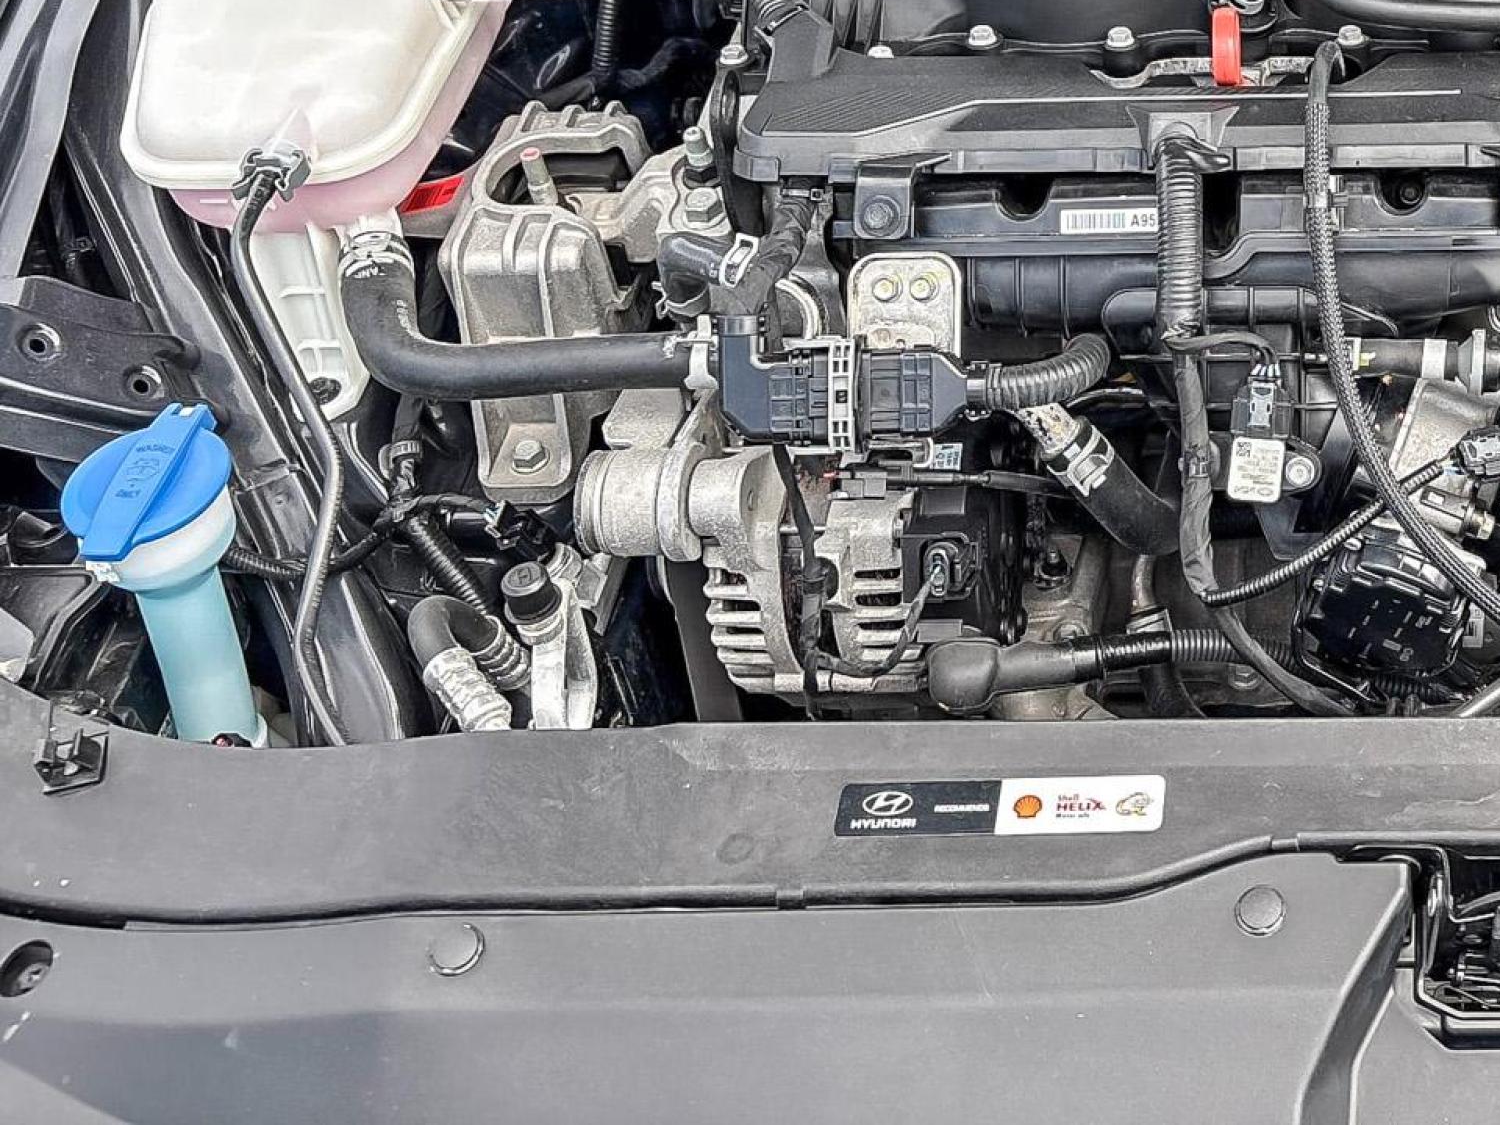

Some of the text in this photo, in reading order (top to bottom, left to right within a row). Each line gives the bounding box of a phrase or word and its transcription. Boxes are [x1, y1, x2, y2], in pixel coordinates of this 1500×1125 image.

[1131, 213, 1156, 228] A95
[1056, 798, 1106, 812] HELIX
[849, 818, 917, 829] HYUNDAI
